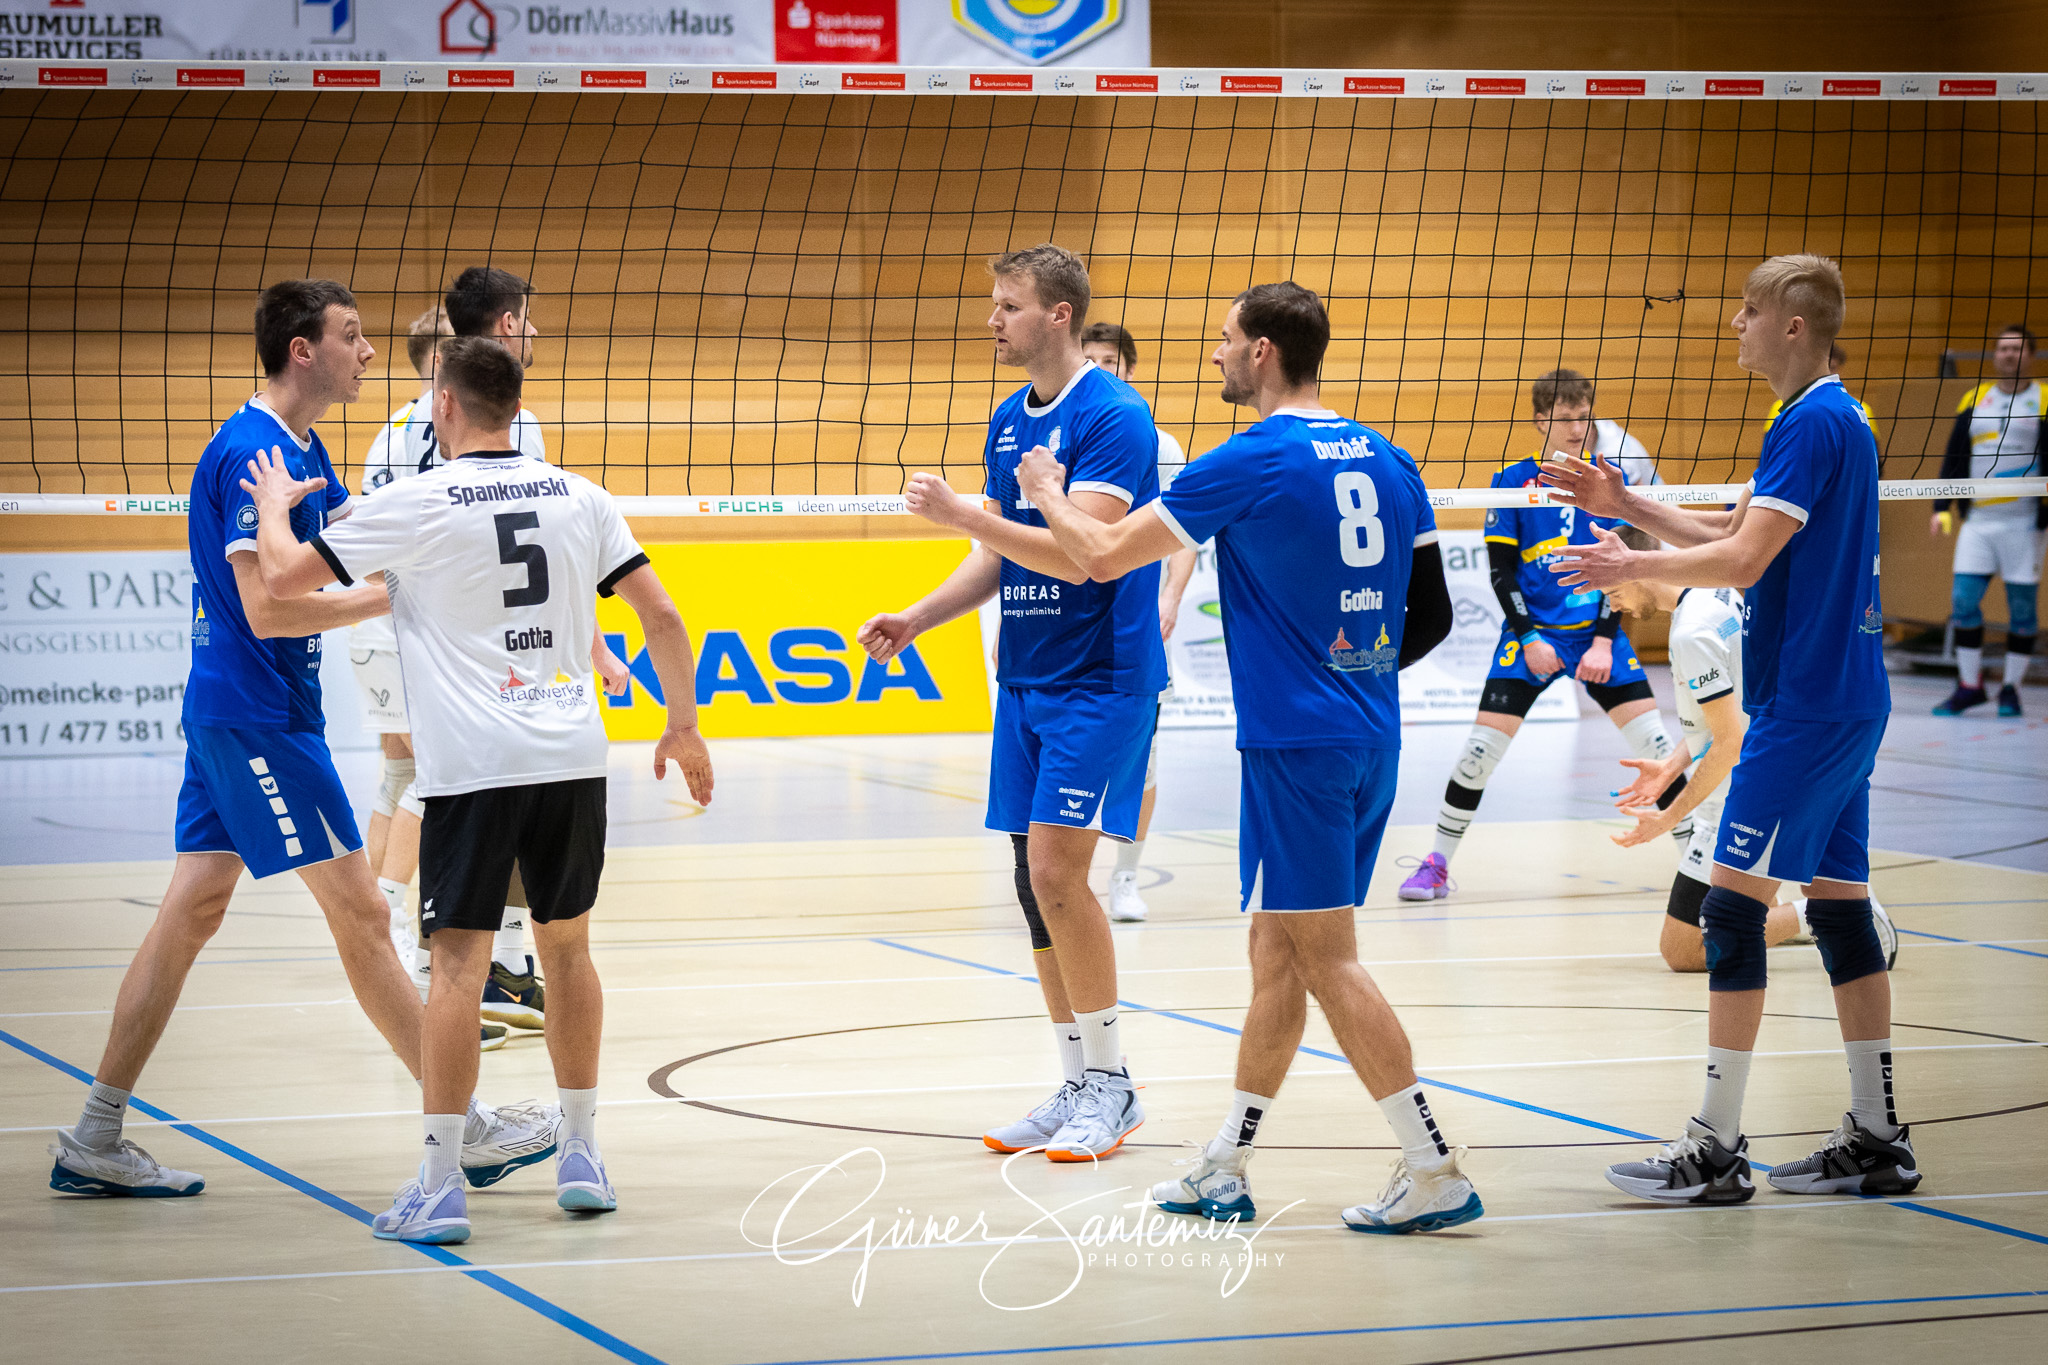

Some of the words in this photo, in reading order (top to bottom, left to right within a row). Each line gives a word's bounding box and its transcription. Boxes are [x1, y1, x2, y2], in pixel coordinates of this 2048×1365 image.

[814, 11, 884, 30] Sparkasse
[815, 30, 881, 50] Nürnberg
[137, 76, 153, 84] Zapf
[274, 76, 290, 84] Zapf
[543, 77, 559, 85] Zapf
[674, 78, 690, 86] Zapf
[804, 79, 820, 87] Zapf
[933, 80, 948, 88] Zapf
[1431, 84, 1445, 92] Zapf
[447, 478, 569, 506] Spankowski
[1657, 489, 1718, 502] umsetzen
[1879, 485, 1912, 497] Ideen
[1917, 484, 1976, 496] umsetzen
[127, 501, 191, 512] FUCHS
[719, 502, 783, 513] FUCHS
[798, 501, 834, 513] Ideen
[839, 501, 904, 513] umsetzen
[1333, 471, 1385, 567] 8
[493, 511, 549, 608] 5
[29, 571, 65, 609] &
[1003, 585, 1060, 600] BOREAS
[1340, 588, 1383, 612] Gotha
[1025, 606, 1061, 616] unlimited
[505, 627, 553, 651] Gotha
[1500, 641, 1520, 667] 3
[1698, 668, 1720, 688] puls
[59, 720, 108, 742] 477
[117, 719, 164, 742] 581
[1059, 809, 1085, 820] erima
[1726, 844, 1750, 859] erima
[1206, 1181, 1237, 1200] MIZUNO
